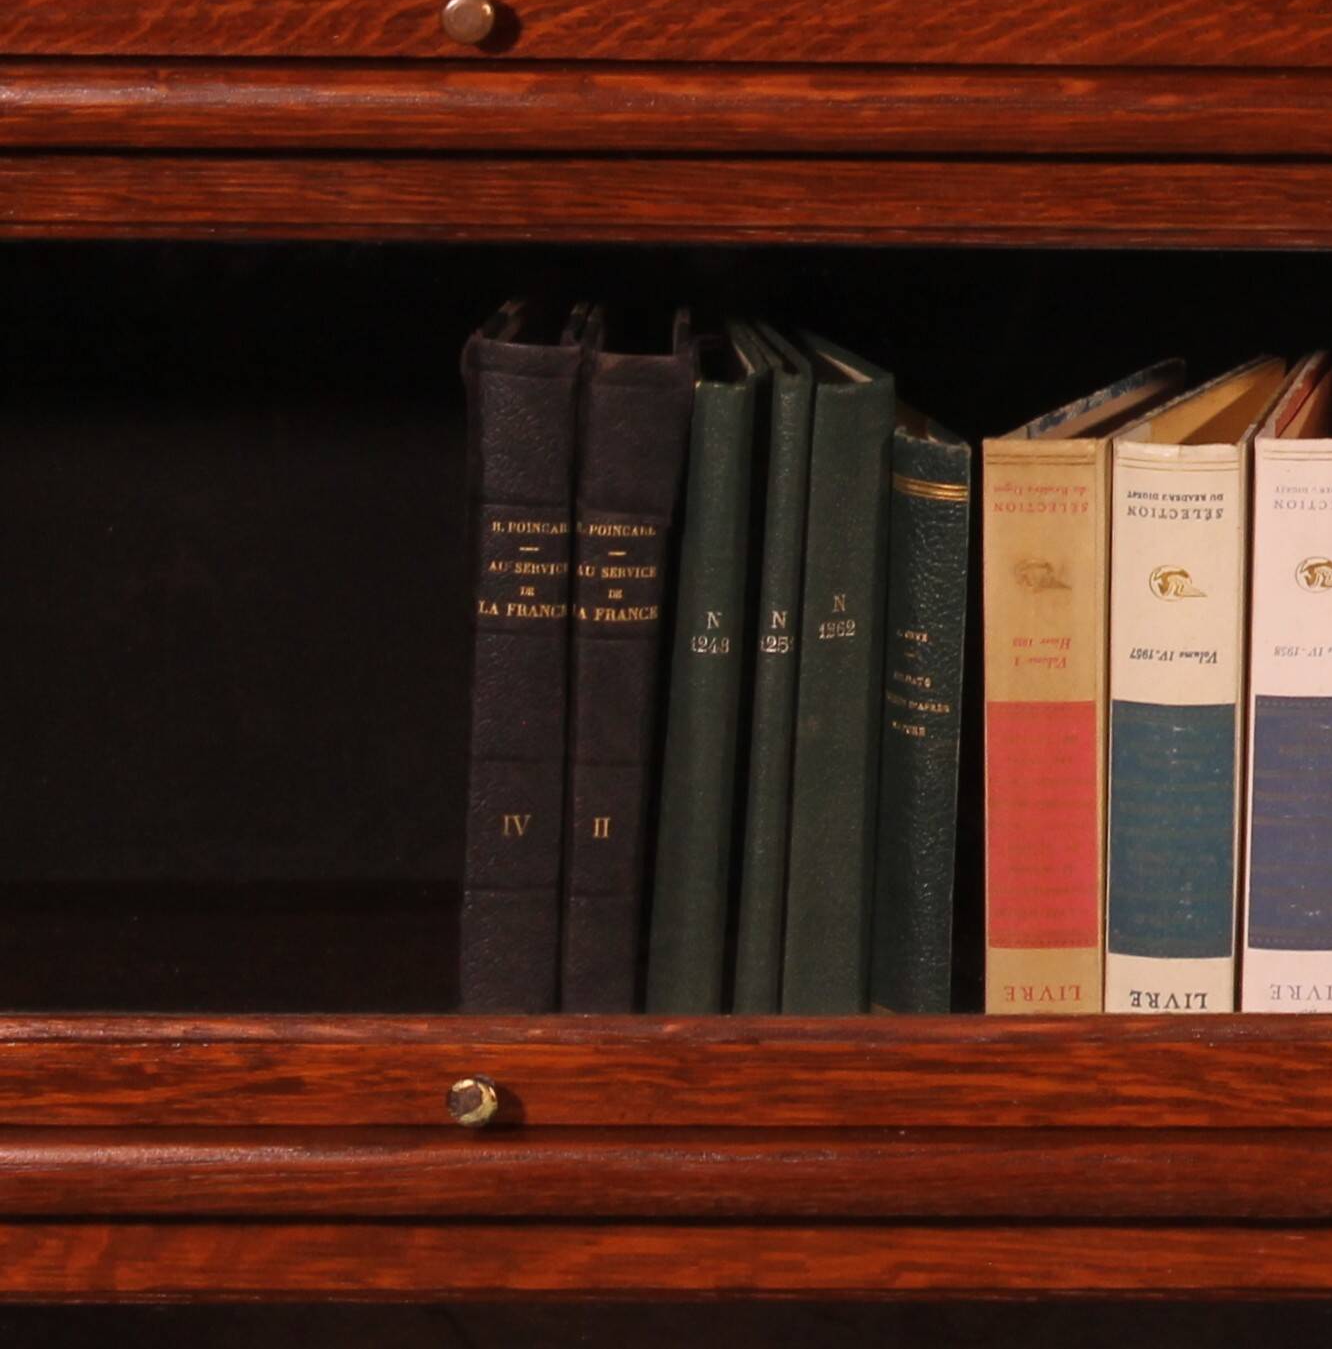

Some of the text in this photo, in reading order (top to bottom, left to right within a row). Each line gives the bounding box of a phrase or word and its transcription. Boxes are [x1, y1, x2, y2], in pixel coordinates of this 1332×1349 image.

[1126, 505, 1225, 521] SÉLECTION
[601, 564, 658, 579] SERVICE
[519, 586, 537, 597] DE
[607, 588, 625, 601] DE
[477, 600, 500, 616] LA
[831, 593, 847, 613] N
[593, 604, 659, 622] FRANCE
[704, 610, 724, 631] N
[768, 609, 790, 630] N
[1177, 649, 1220, 665] Volume
[503, 813, 533, 837] IV
[592, 816, 612, 840] II
[1004, 984, 1082, 1002] LIVRE
[1129, 989, 1208, 1010] LIVRE
